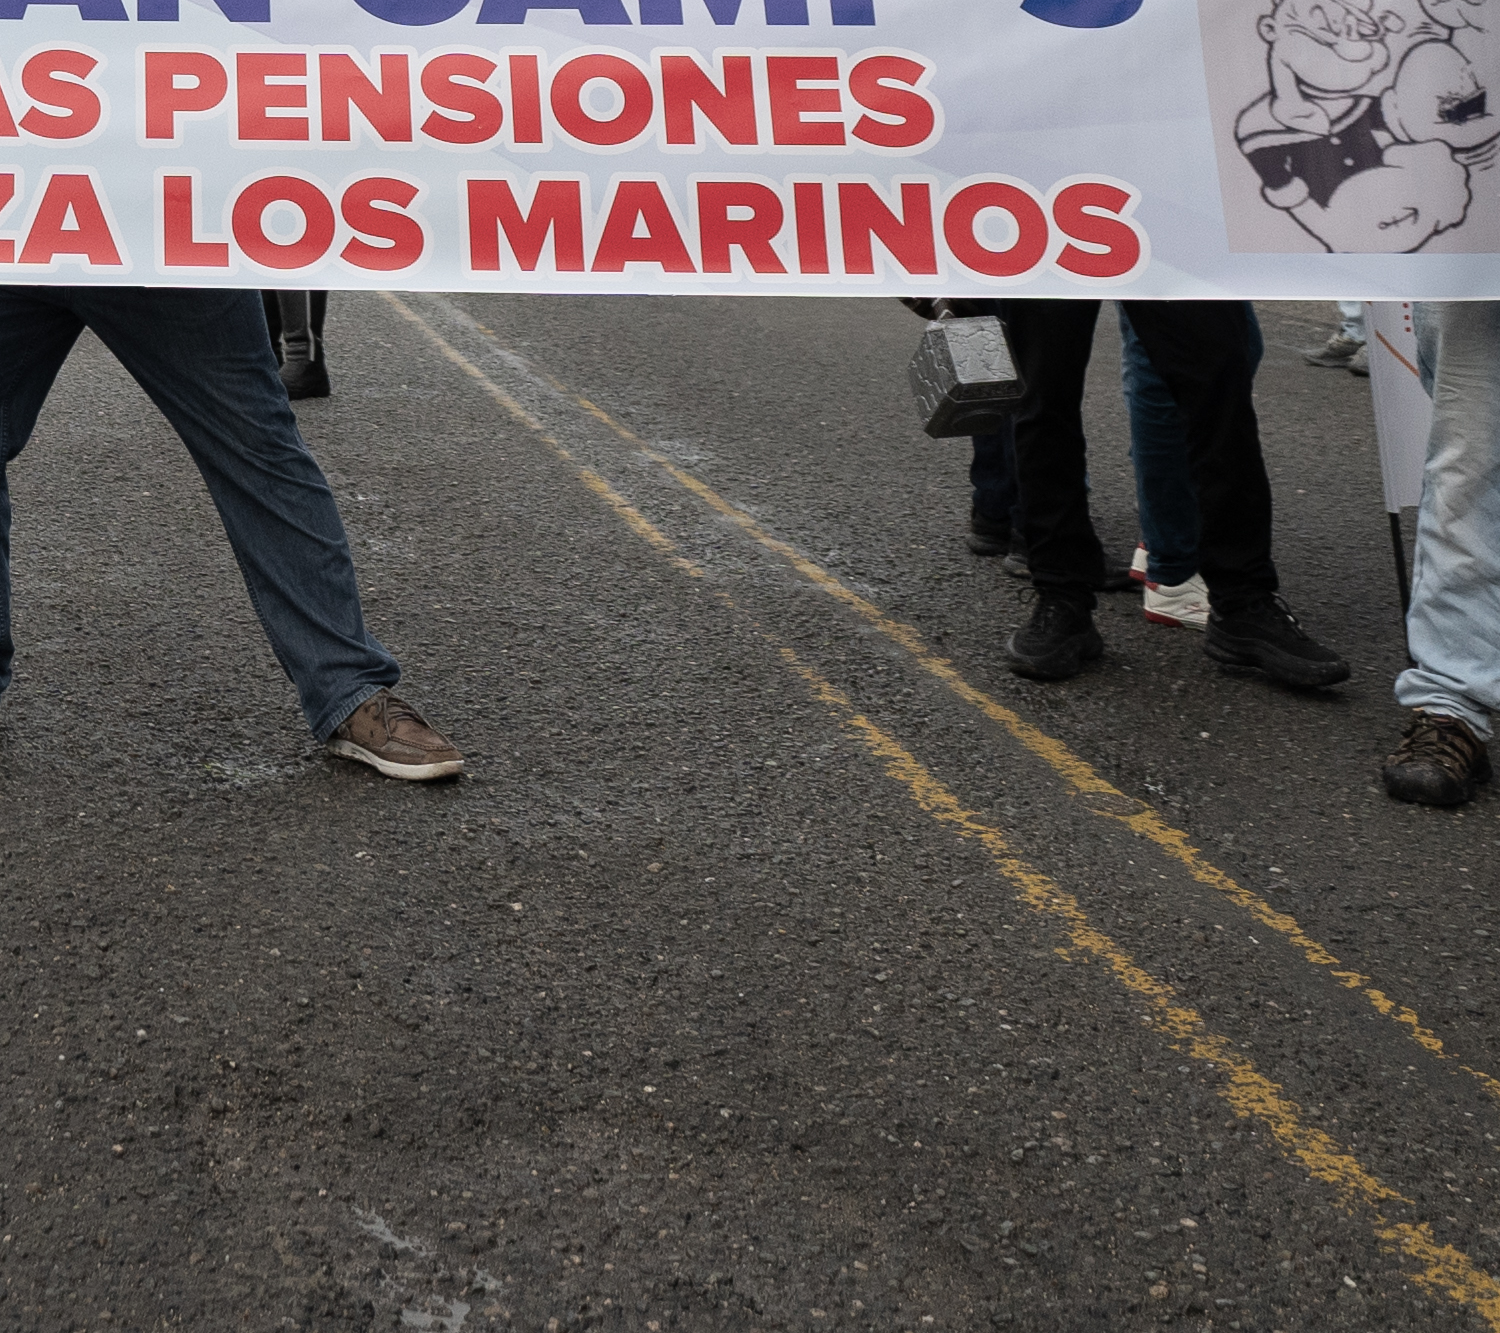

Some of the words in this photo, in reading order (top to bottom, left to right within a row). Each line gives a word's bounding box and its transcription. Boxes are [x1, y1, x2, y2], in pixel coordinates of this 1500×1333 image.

[145, 50, 936, 147] PENSIONES
[162, 175, 426, 271] LOS
[464, 180, 1140, 278] MARINOS
